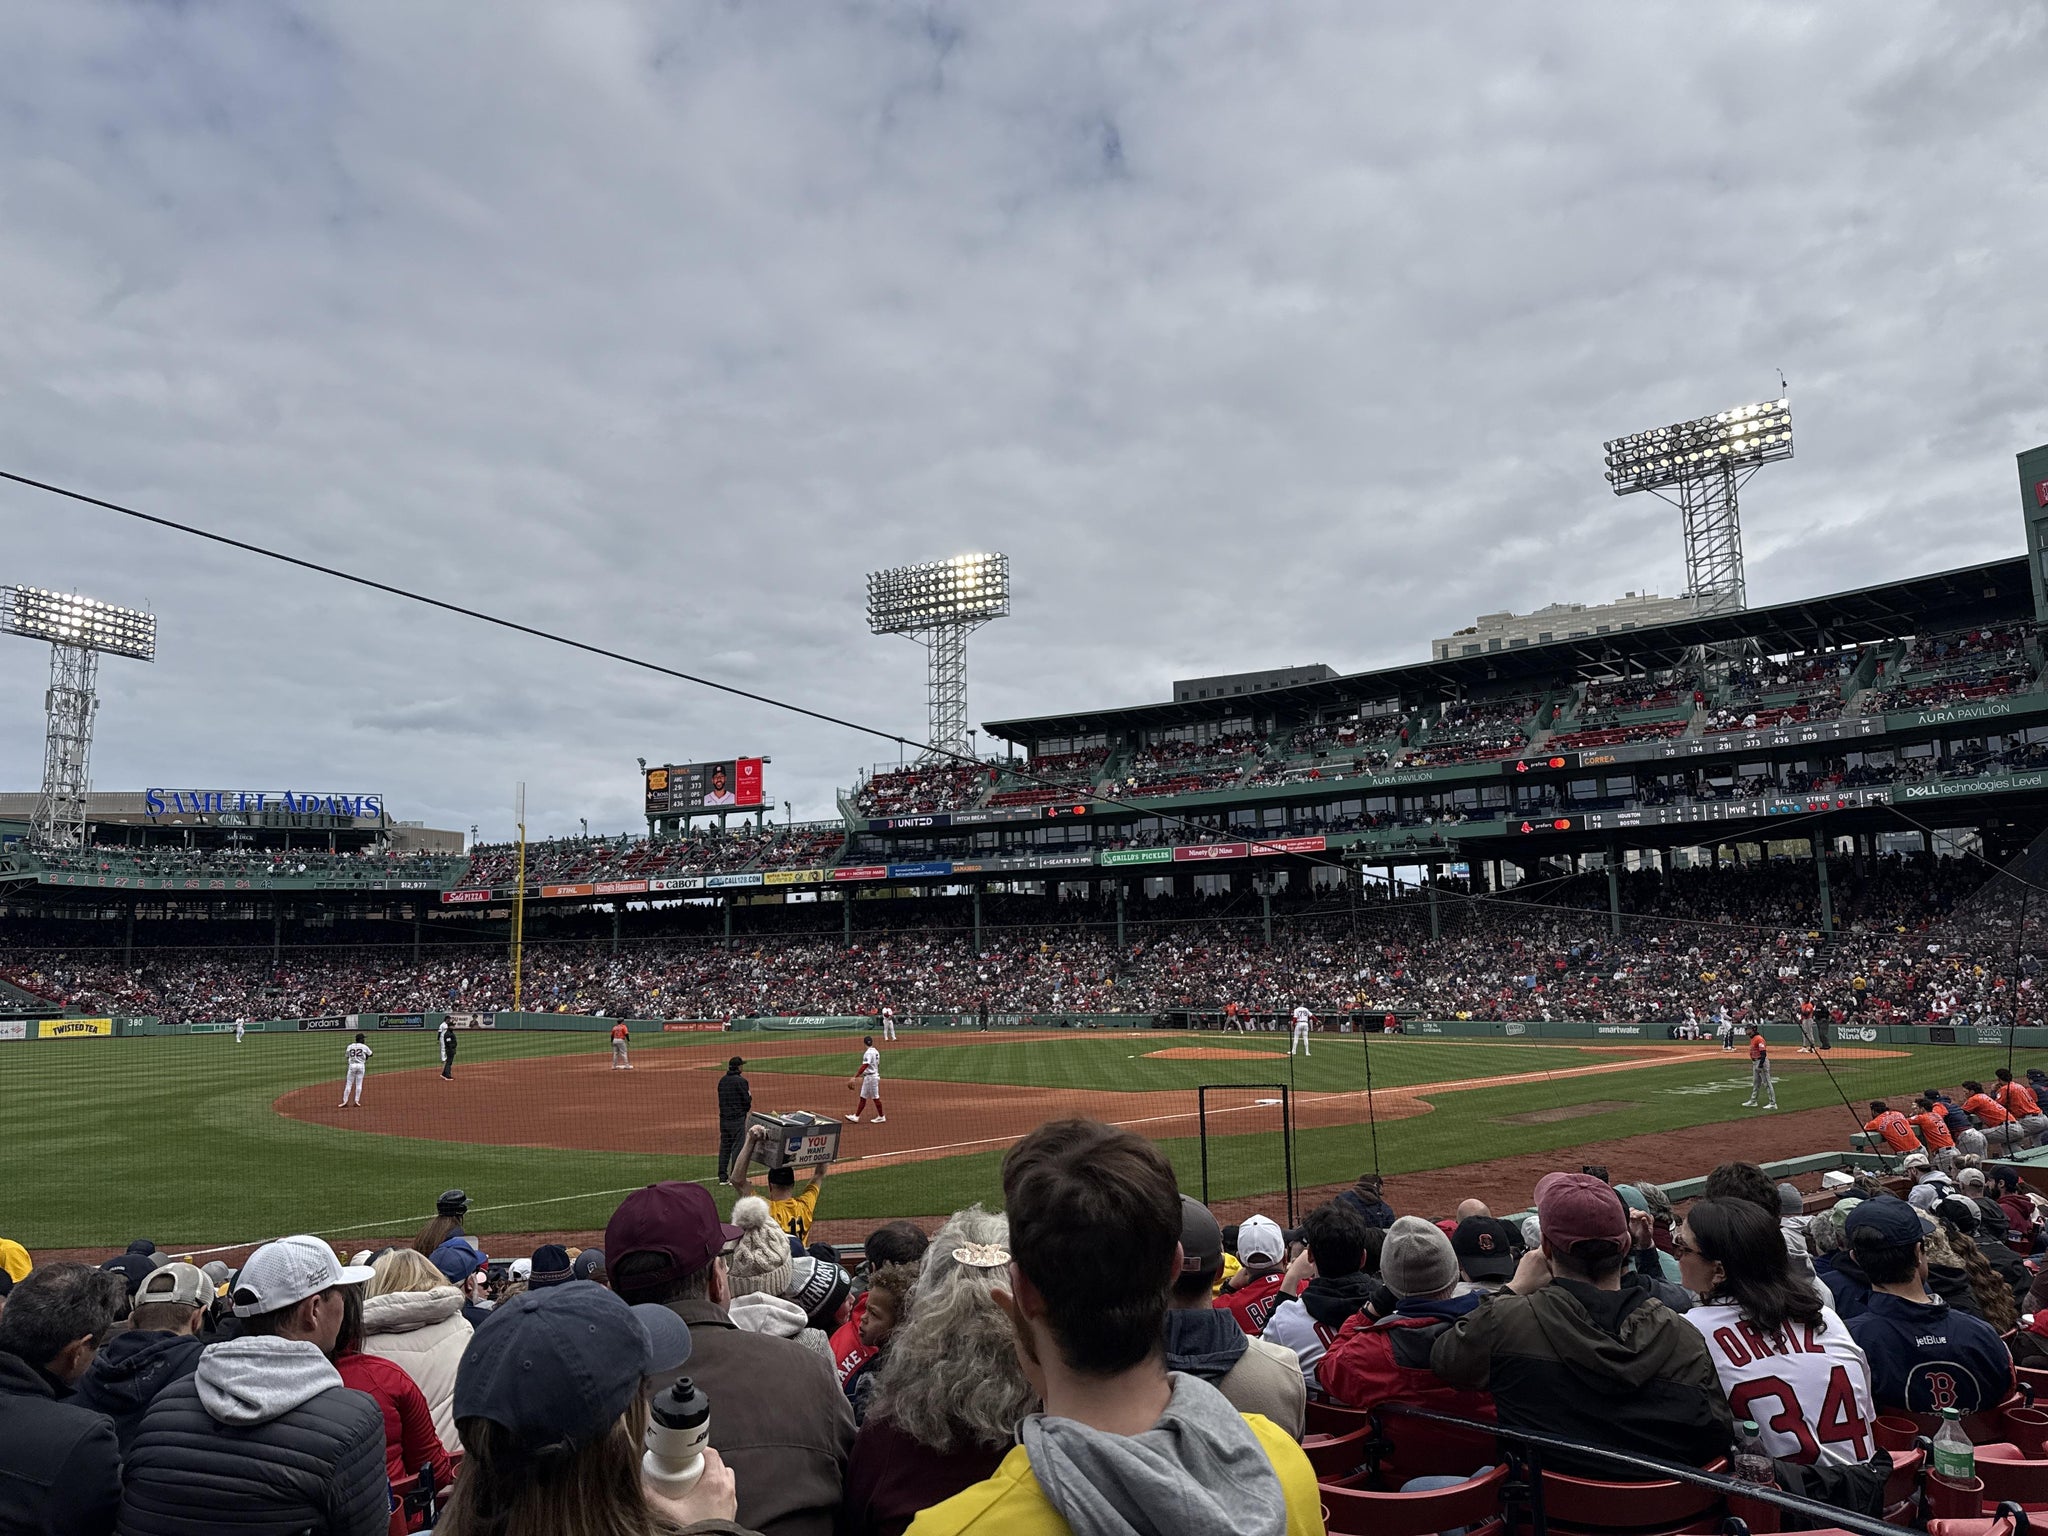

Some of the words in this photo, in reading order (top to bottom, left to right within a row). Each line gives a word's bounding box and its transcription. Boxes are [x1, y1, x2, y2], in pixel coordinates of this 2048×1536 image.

[1957, 704, 2010, 719] PAVILION
[1744, 739, 1760, 748] .373
[1772, 736, 1790, 744] .436
[1800, 733, 1818, 742] .809
[1584, 756, 1616, 764] CORREA
[1398, 772, 1432, 782] PAVILION
[1906, 786, 1939, 797] DELL
[1938, 778, 2009, 794] Technologies
[2012, 774, 2042, 787] Level
[146, 788, 267, 817] SAMUEL
[278, 790, 380, 819] ADAMS
[898, 817, 932, 828] UNITED
[1112, 853, 1140, 862] GRILLO'S
[1142, 852, 1170, 860] PICKLES
[1188, 849, 1208, 858] Ninety
[67, 875, 75, 884] 4
[114, 878, 129, 887] 27
[160, 880, 173, 889] 14
[235, 880, 250, 889] 34
[260, 880, 273, 888] 42
[596, 884, 615, 893] King's
[615, 882, 646, 892] Hawaiian
[556, 886, 578, 894] STIHL
[464, 892, 483, 900] PIZZA
[128, 1018, 143, 1027] 380
[788, 1016, 826, 1025] L.L.Bean
[961, 1016, 972, 1025] JIM
[52, 1023, 84, 1036] TWISTED
[85, 1024, 98, 1034] TEA
[1598, 1026, 1640, 1034] smartwater
[1838, 1032, 1860, 1040] Nine
[350, 1049, 363, 1057] 32
[1892, 1120, 1908, 1136] 0
[808, 1136, 828, 1147] YOU
[1915, 1335, 1947, 1347] jetBlue
[1924, 1372, 1958, 1412] B
[1728, 1364, 1869, 1466] 34
